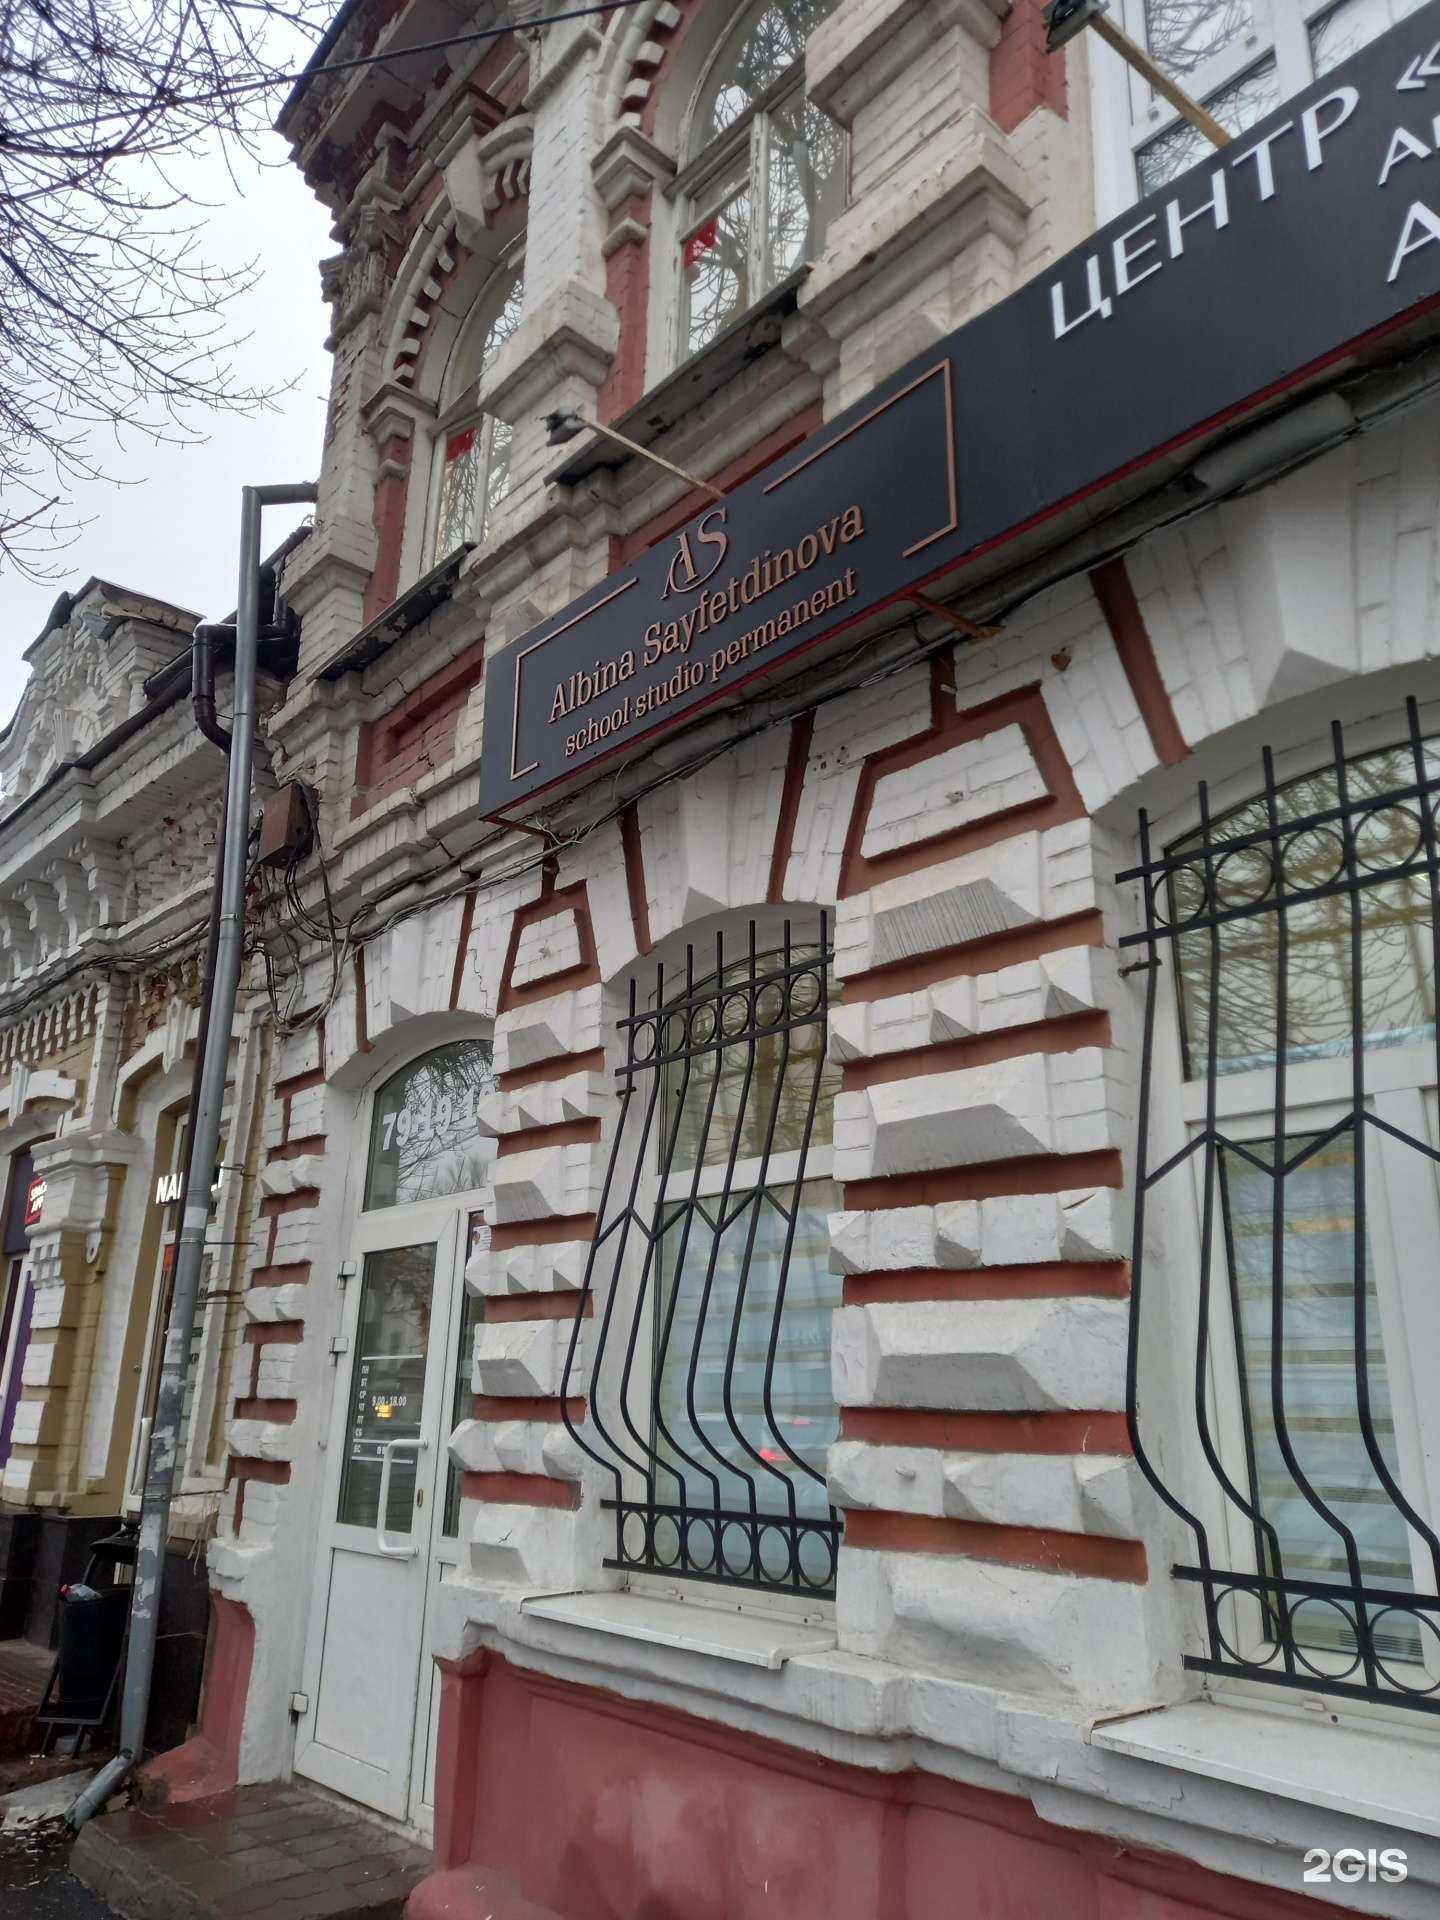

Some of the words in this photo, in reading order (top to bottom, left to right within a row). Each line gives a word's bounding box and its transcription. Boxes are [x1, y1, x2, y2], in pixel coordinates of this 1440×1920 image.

[1051, 86, 1360, 340] ЦЕНТР
[548, 650, 635, 723] Albina
[643, 505, 864, 668] Sayfetdinova
[565, 697, 629, 757] school
[635, 661, 705, 718] studio
[710, 568, 857, 683] permanent
[359, 1390, 366, 1400] СР
[361, 1365, 369, 1375] ПН
